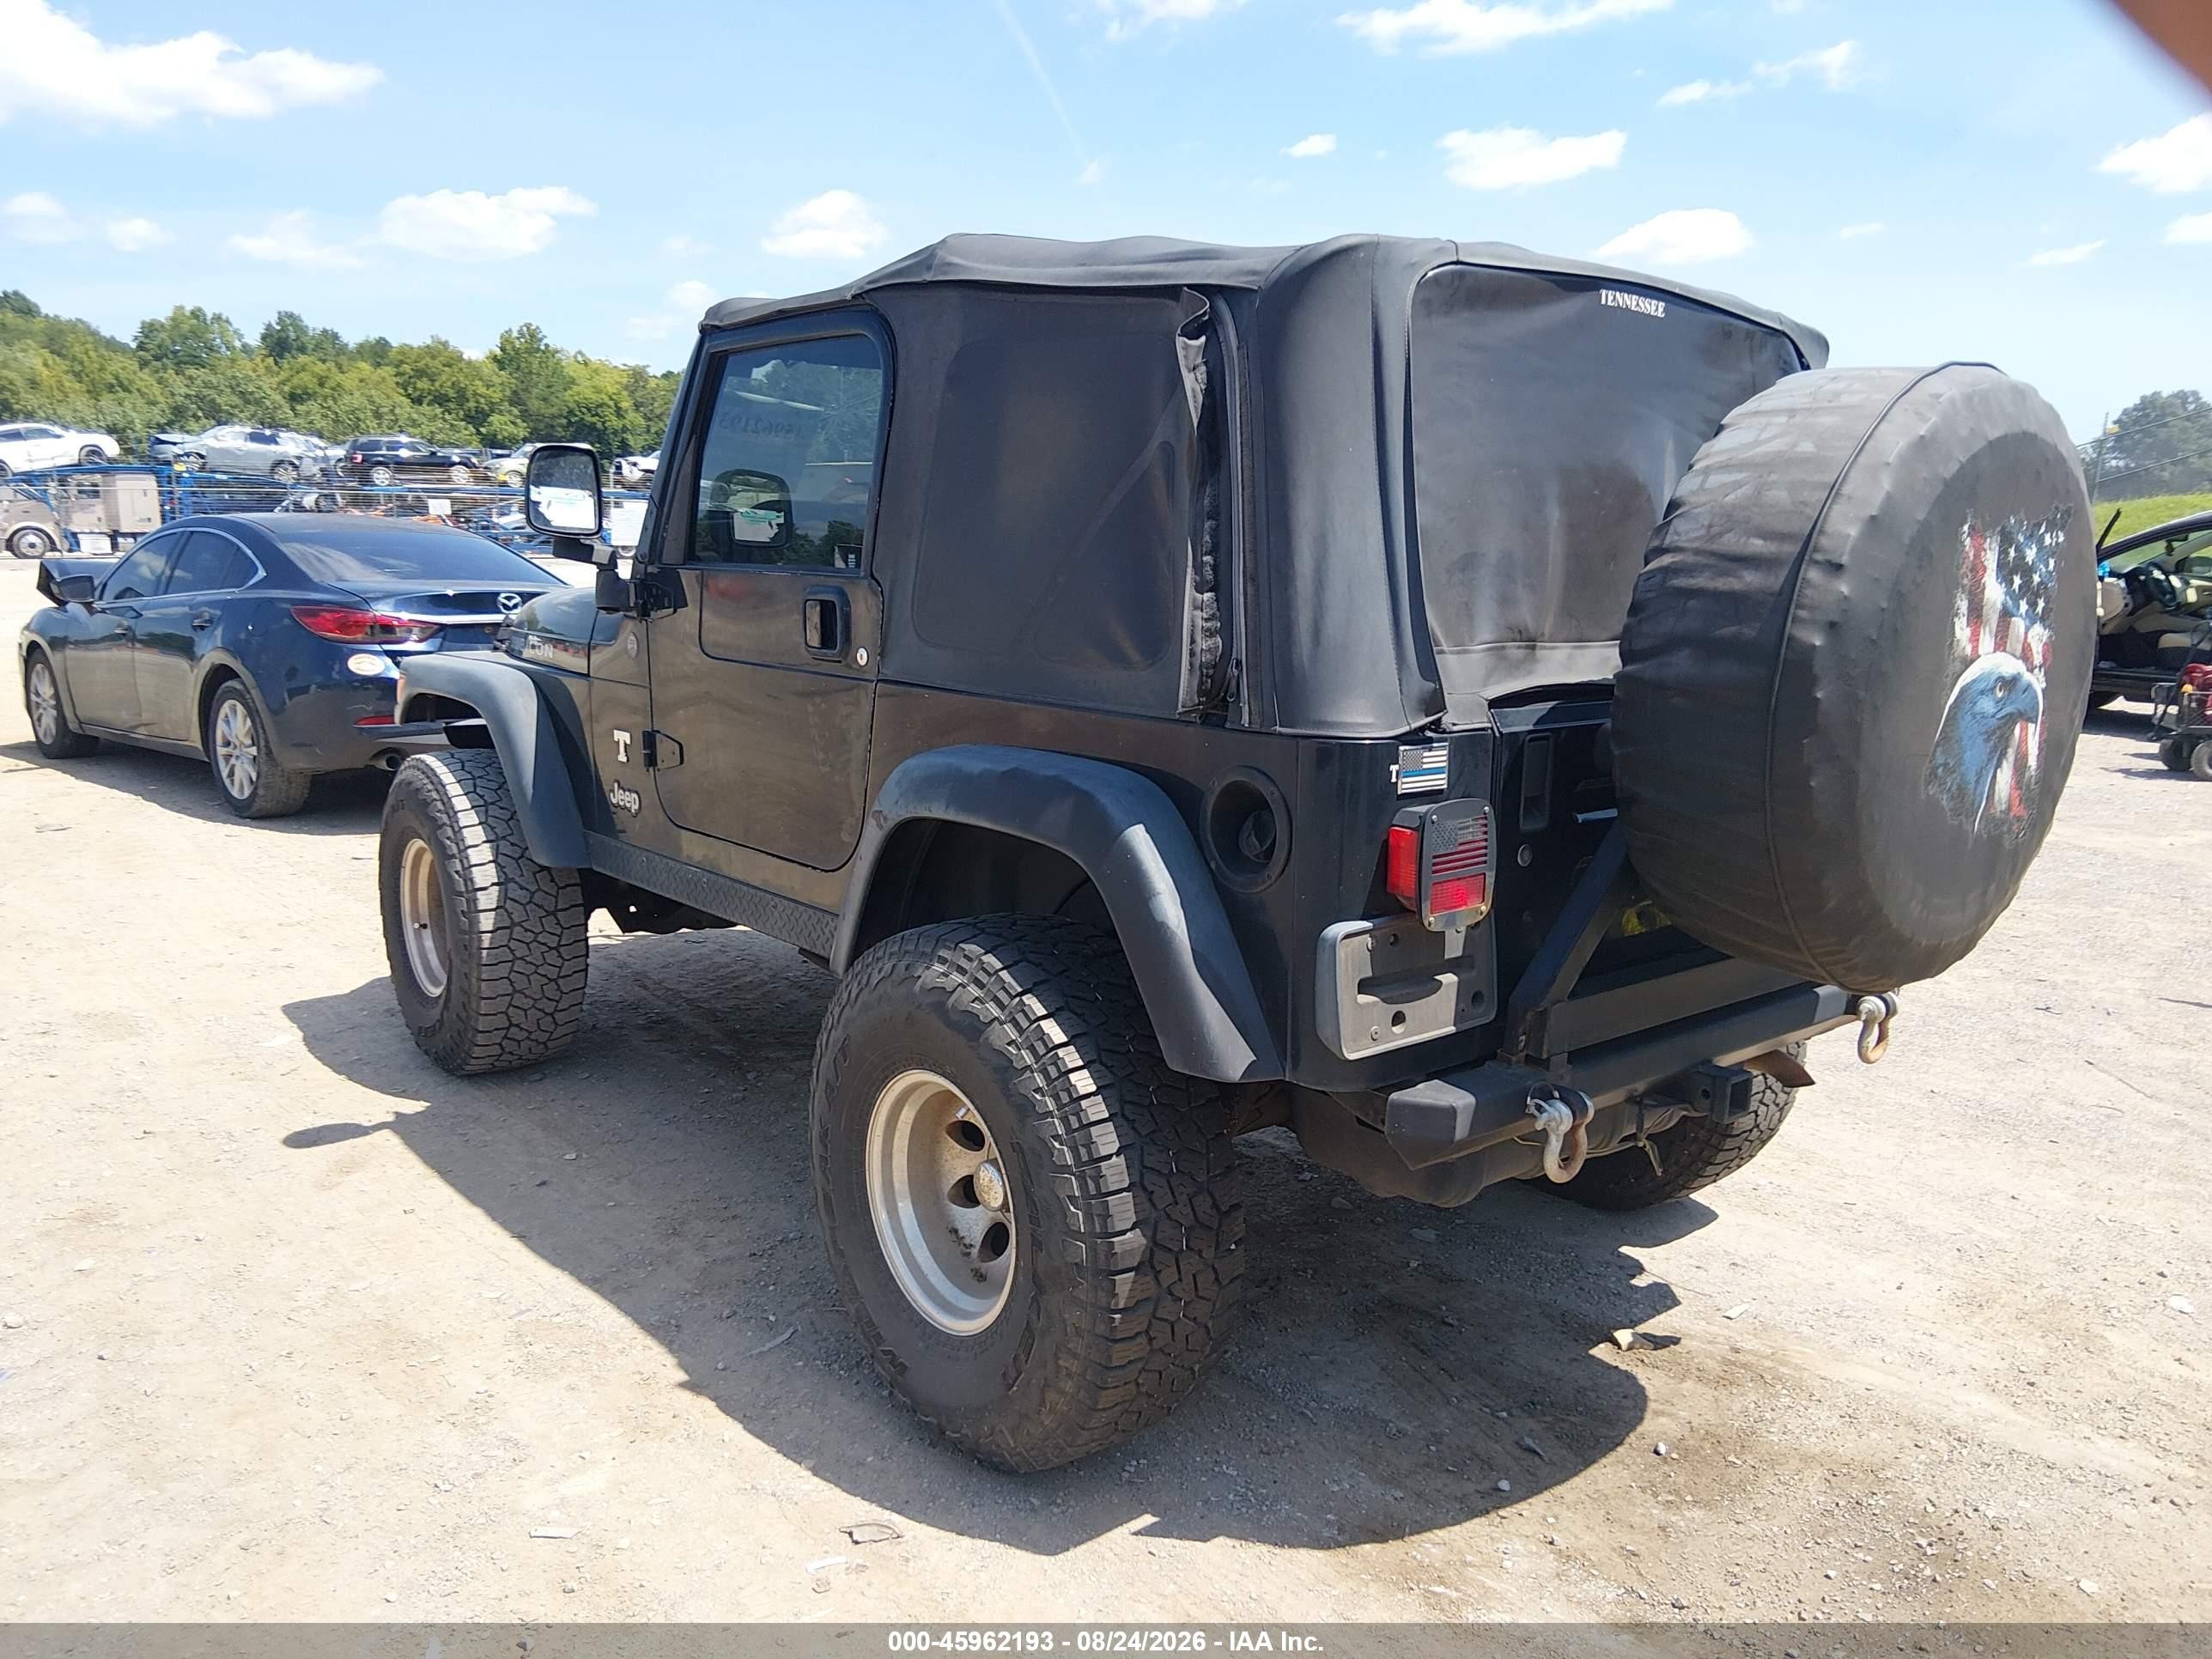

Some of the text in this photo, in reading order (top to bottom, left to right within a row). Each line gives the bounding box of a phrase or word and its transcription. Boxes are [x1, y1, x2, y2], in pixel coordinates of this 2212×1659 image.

[1599, 289, 1666, 319] TENNESSEE
[612, 729, 631, 763] T
[1389, 763, 1400, 783] T
[609, 781, 641, 817] Jeep
